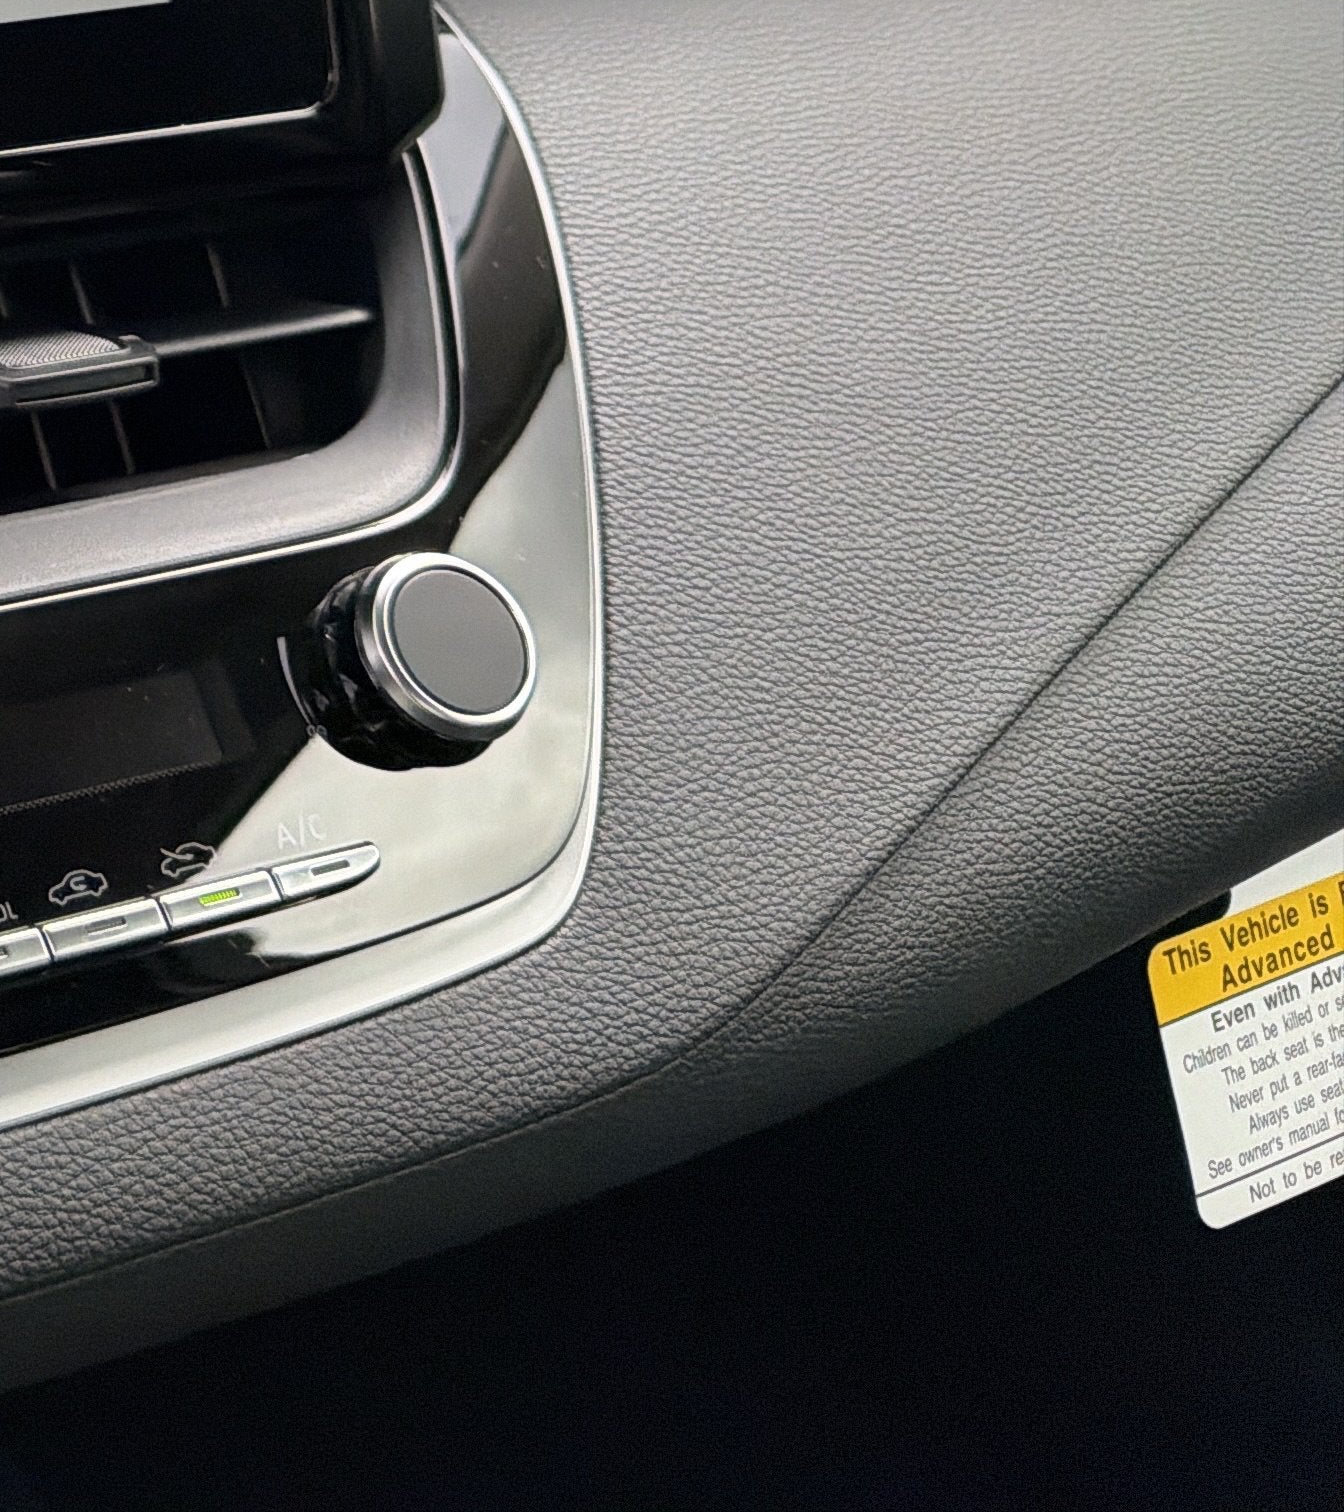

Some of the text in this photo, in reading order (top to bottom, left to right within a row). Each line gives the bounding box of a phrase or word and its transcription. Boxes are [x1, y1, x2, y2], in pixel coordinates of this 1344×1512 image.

[277, 809, 327, 850] A/C
[1162, 939, 1212, 975] This
[1220, 904, 1299, 952] Vehicle
[1308, 892, 1329, 918] is
[1222, 923, 1335, 992] Advanced
[1211, 965, 1344, 1033] Even with Adv
[1183, 1042, 1232, 1074] Children
[1236, 1031, 1259, 1052] can
[1261, 1022, 1279, 1041] be
[1282, 1004, 1313, 1032] killed
[1317, 1000, 1330, 1018] or
[1221, 1065, 1246, 1086] The
[1249, 1049, 1280, 1075] back
[1283, 1037, 1310, 1061] seat
[1313, 1031, 1324, 1049] is
[1229, 1050, 1344, 1113] Never put a rear-fa
[1248, 1104, 1289, 1135] Always
[1294, 1093, 1316, 1114] use
[1207, 1159, 1233, 1179] See
[1238, 1136, 1284, 1167] owner's
[1288, 1112, 1330, 1145] manual
[1249, 1178, 1277, 1203] Not
[1283, 1171, 1297, 1189] to
[1303, 1160, 1323, 1180] be
